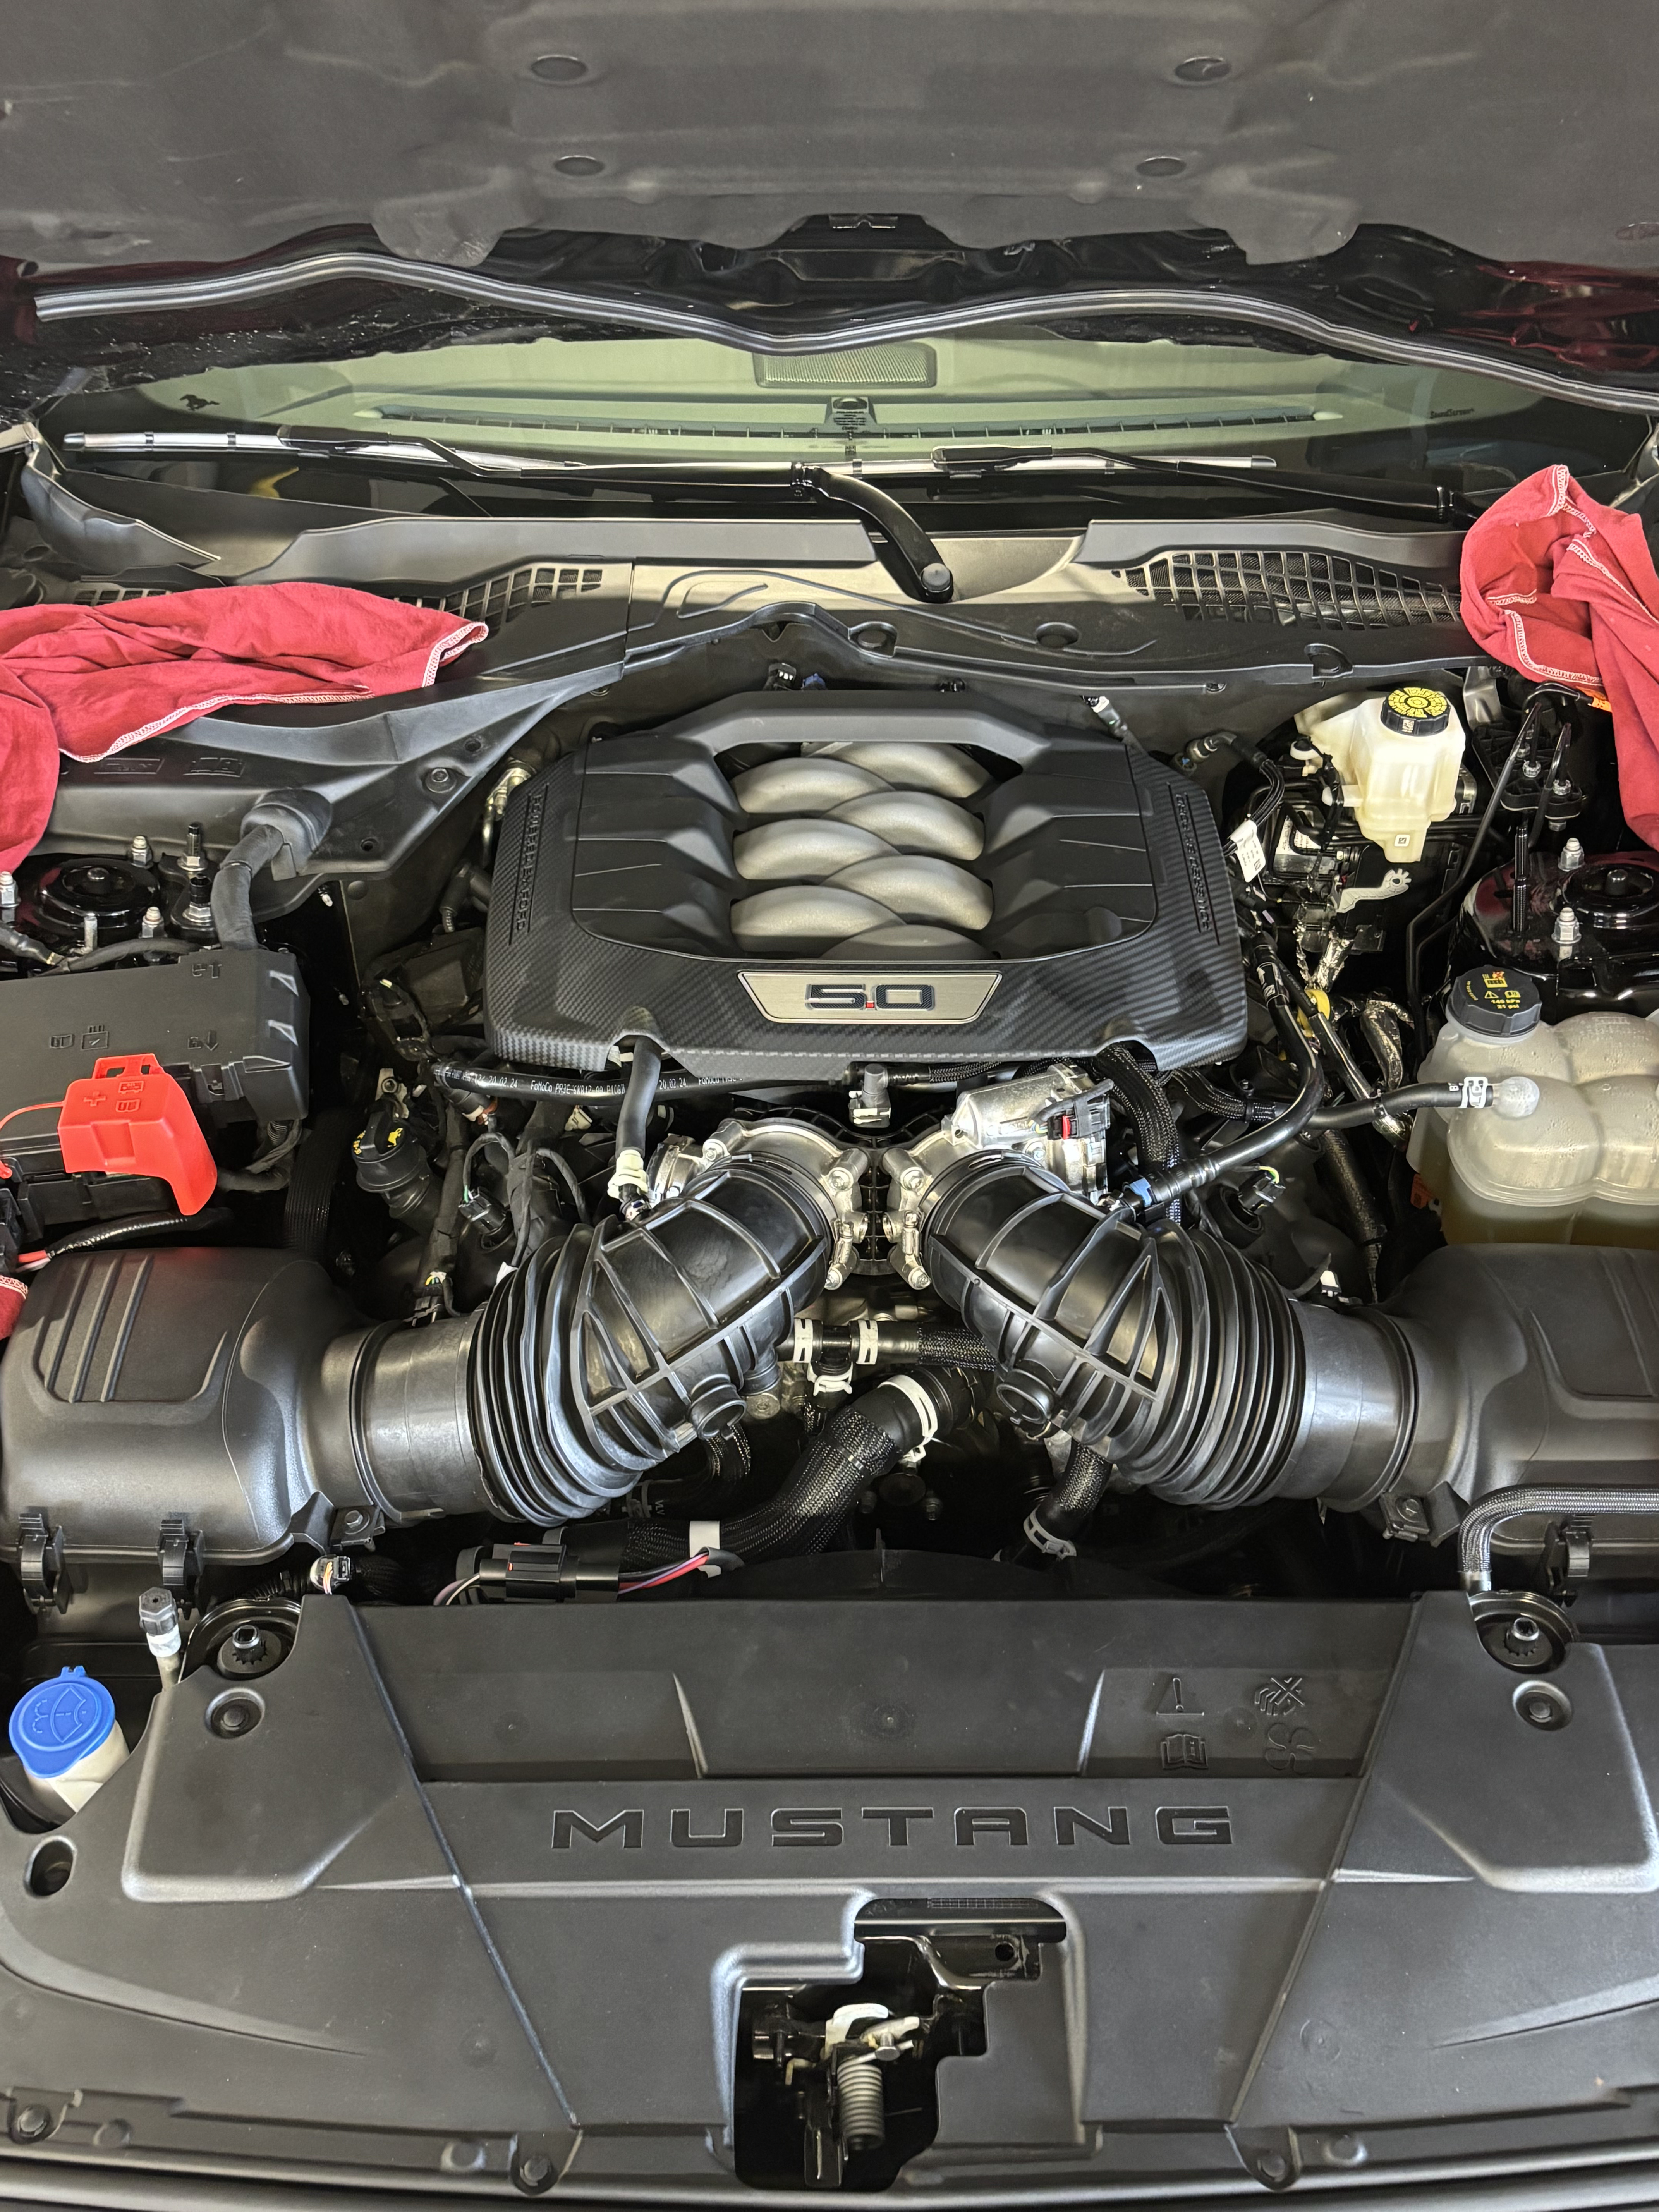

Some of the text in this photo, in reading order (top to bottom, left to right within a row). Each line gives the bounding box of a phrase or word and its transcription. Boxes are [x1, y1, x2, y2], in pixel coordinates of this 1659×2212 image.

[525, 794, 542, 862] POWERED
[517, 888, 530, 931] FORD
[805, 984, 935, 1010] 5.0
[531, 1080, 553, 1092] FoMoCo
[659, 1077, 687, 1090] 20.02.24
[551, 1806, 1233, 1849] MUSTANG
